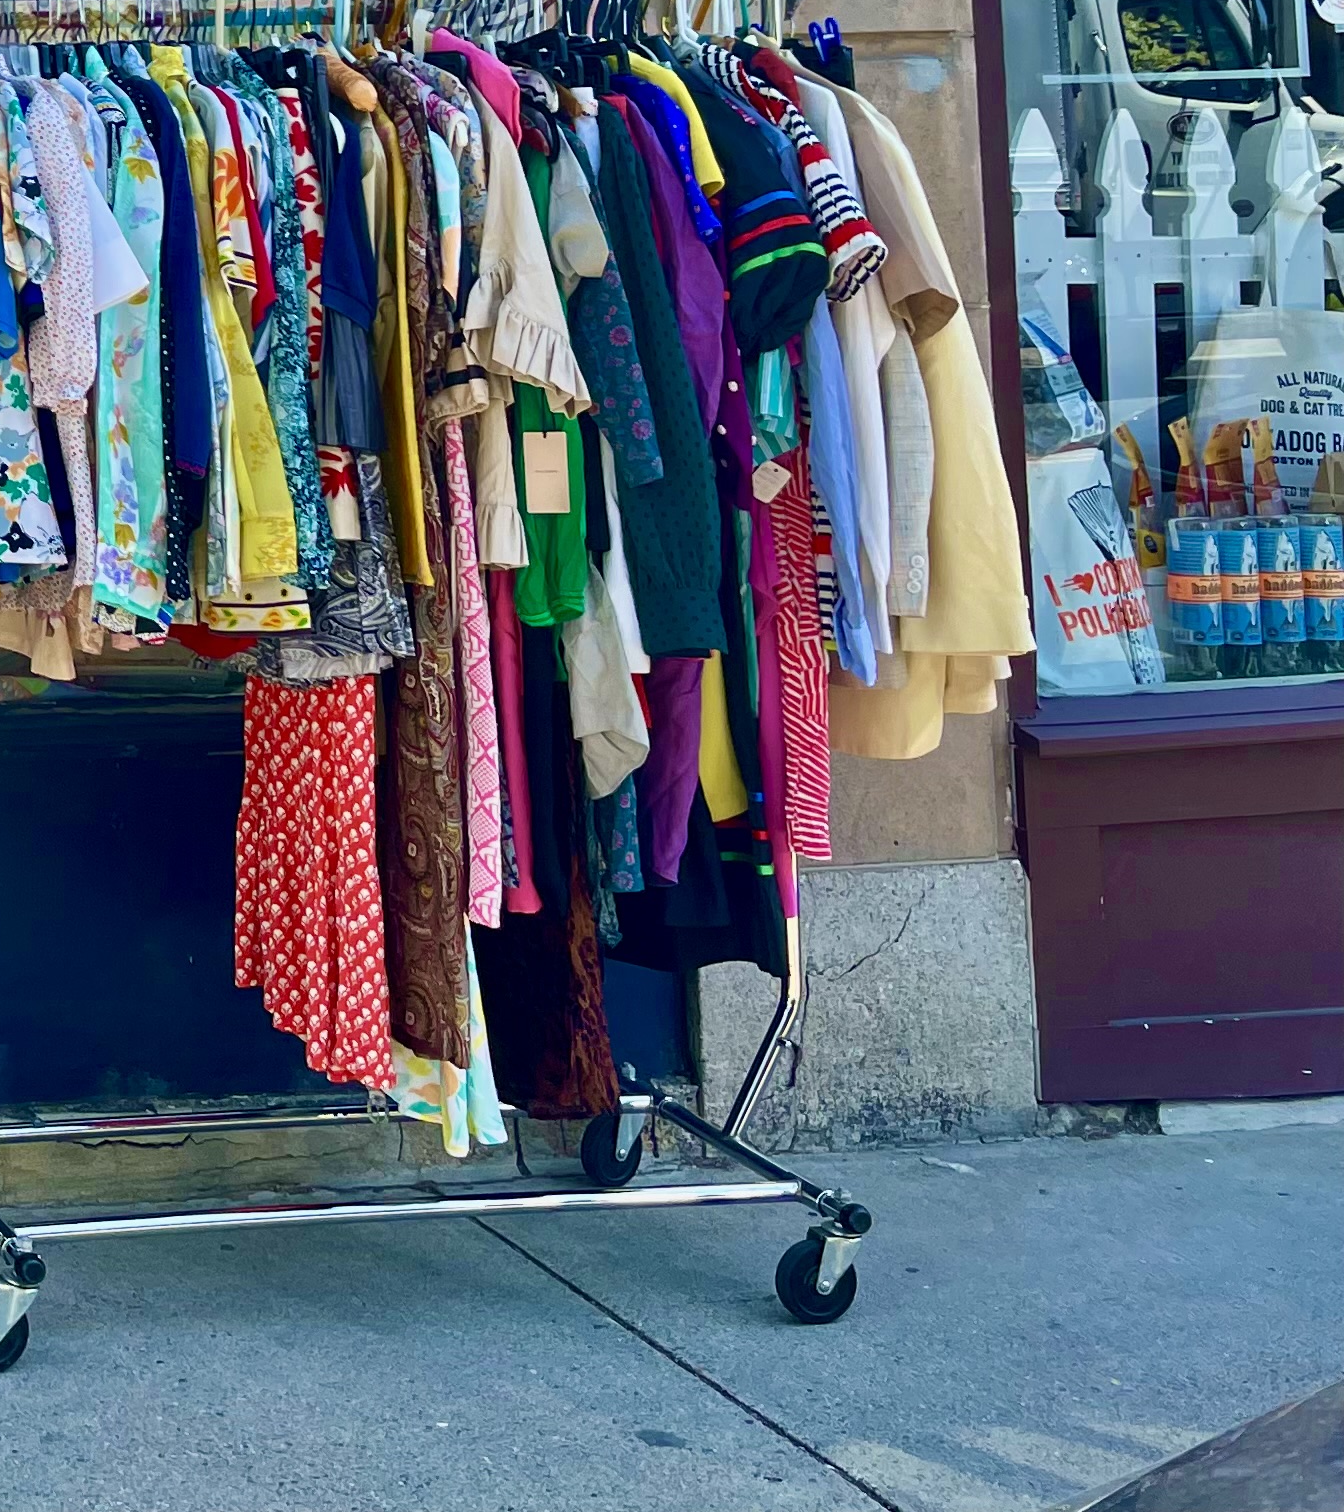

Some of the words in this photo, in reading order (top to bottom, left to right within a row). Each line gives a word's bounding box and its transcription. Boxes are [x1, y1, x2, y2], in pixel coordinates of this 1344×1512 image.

[1276, 371, 1300, 388] ALL
[1304, 370, 1344, 393] NATURA
[1260, 399, 1285, 414] DOG
[1289, 400, 1300, 414] &
[1303, 401, 1324, 416] CAT
